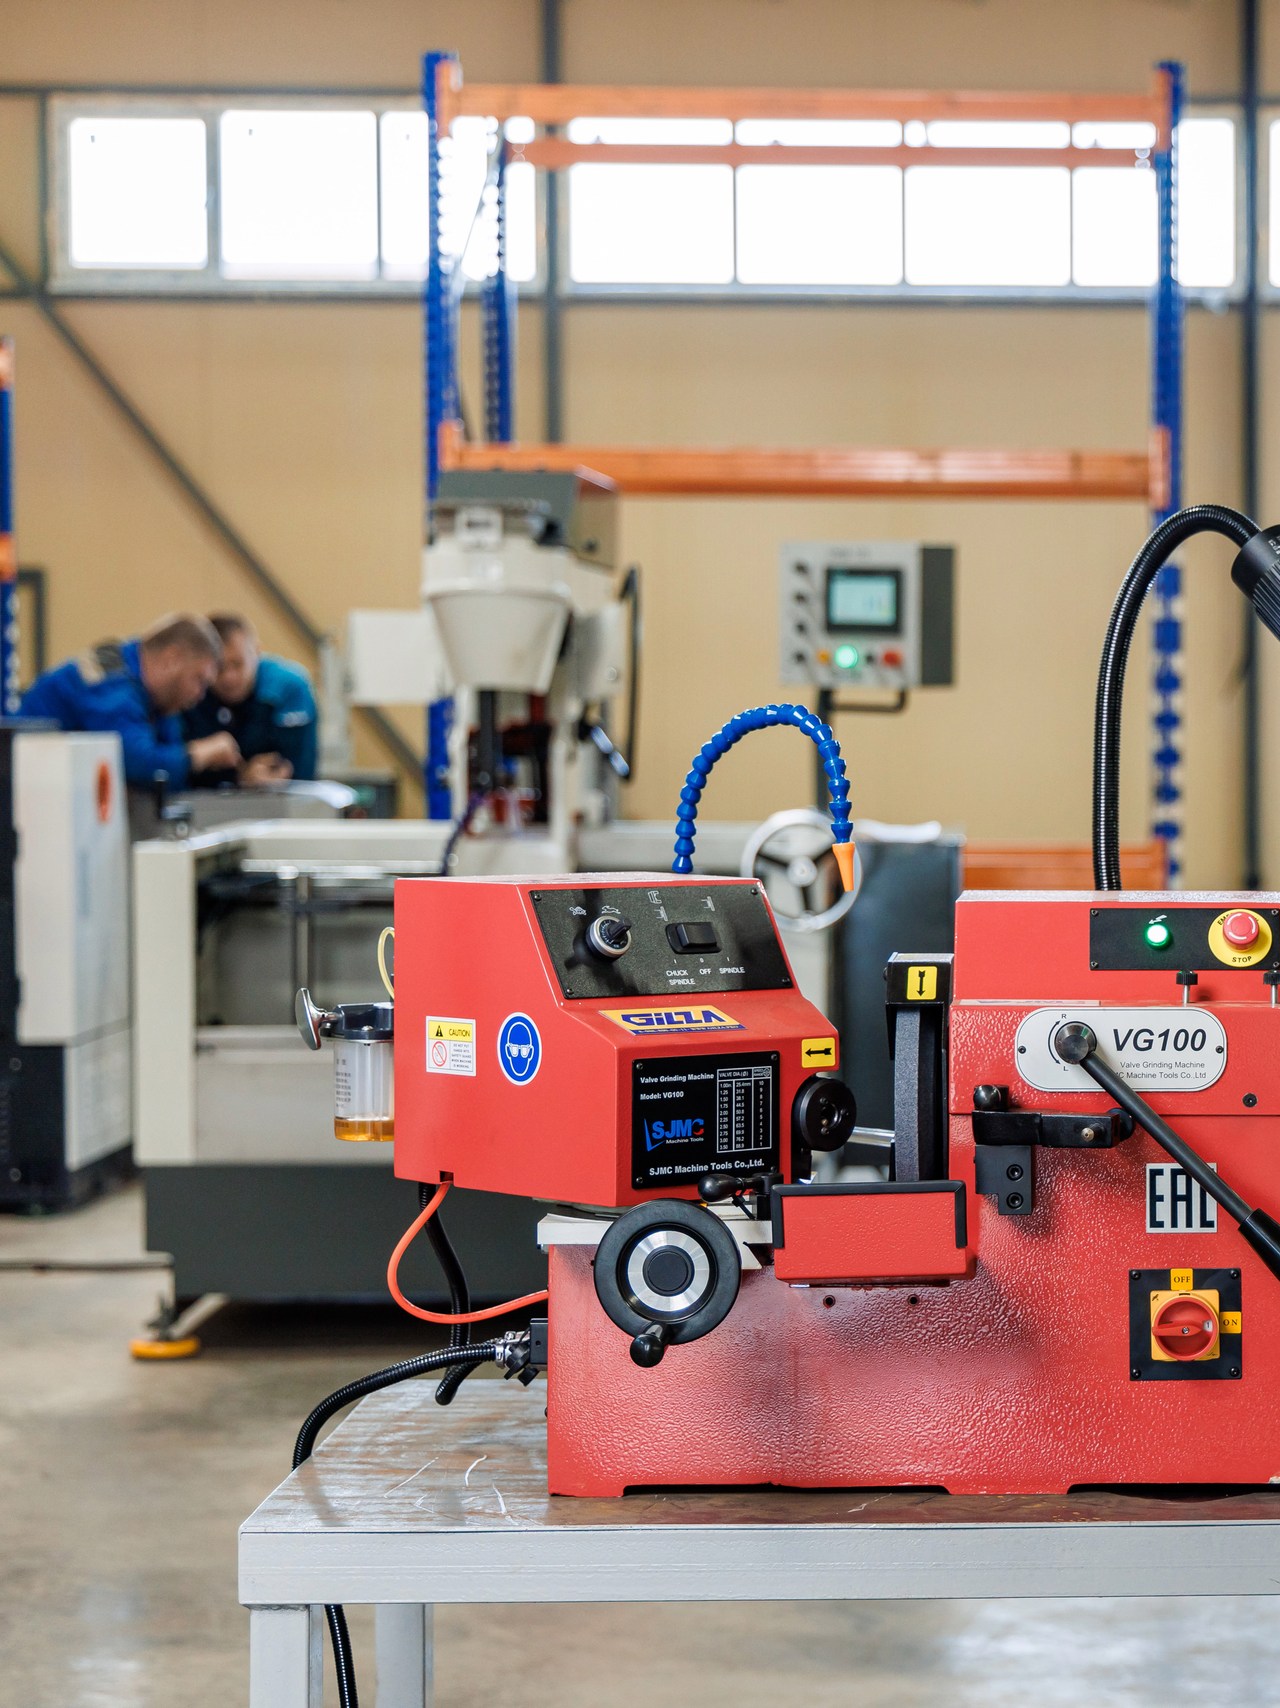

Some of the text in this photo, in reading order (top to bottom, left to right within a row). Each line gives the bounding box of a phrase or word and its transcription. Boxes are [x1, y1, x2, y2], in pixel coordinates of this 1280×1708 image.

[449, 1029, 470, 1037] CAUTION
[1113, 1028, 1206, 1052] VG100
[1142, 1061, 1173, 1069] Grinding
[640, 1073, 714, 1084] Valve Grinding Machine
[652, 1119, 704, 1139] SJMC
[649, 1159, 764, 1176] SJMC Machine Tools Co.,Ltd.
